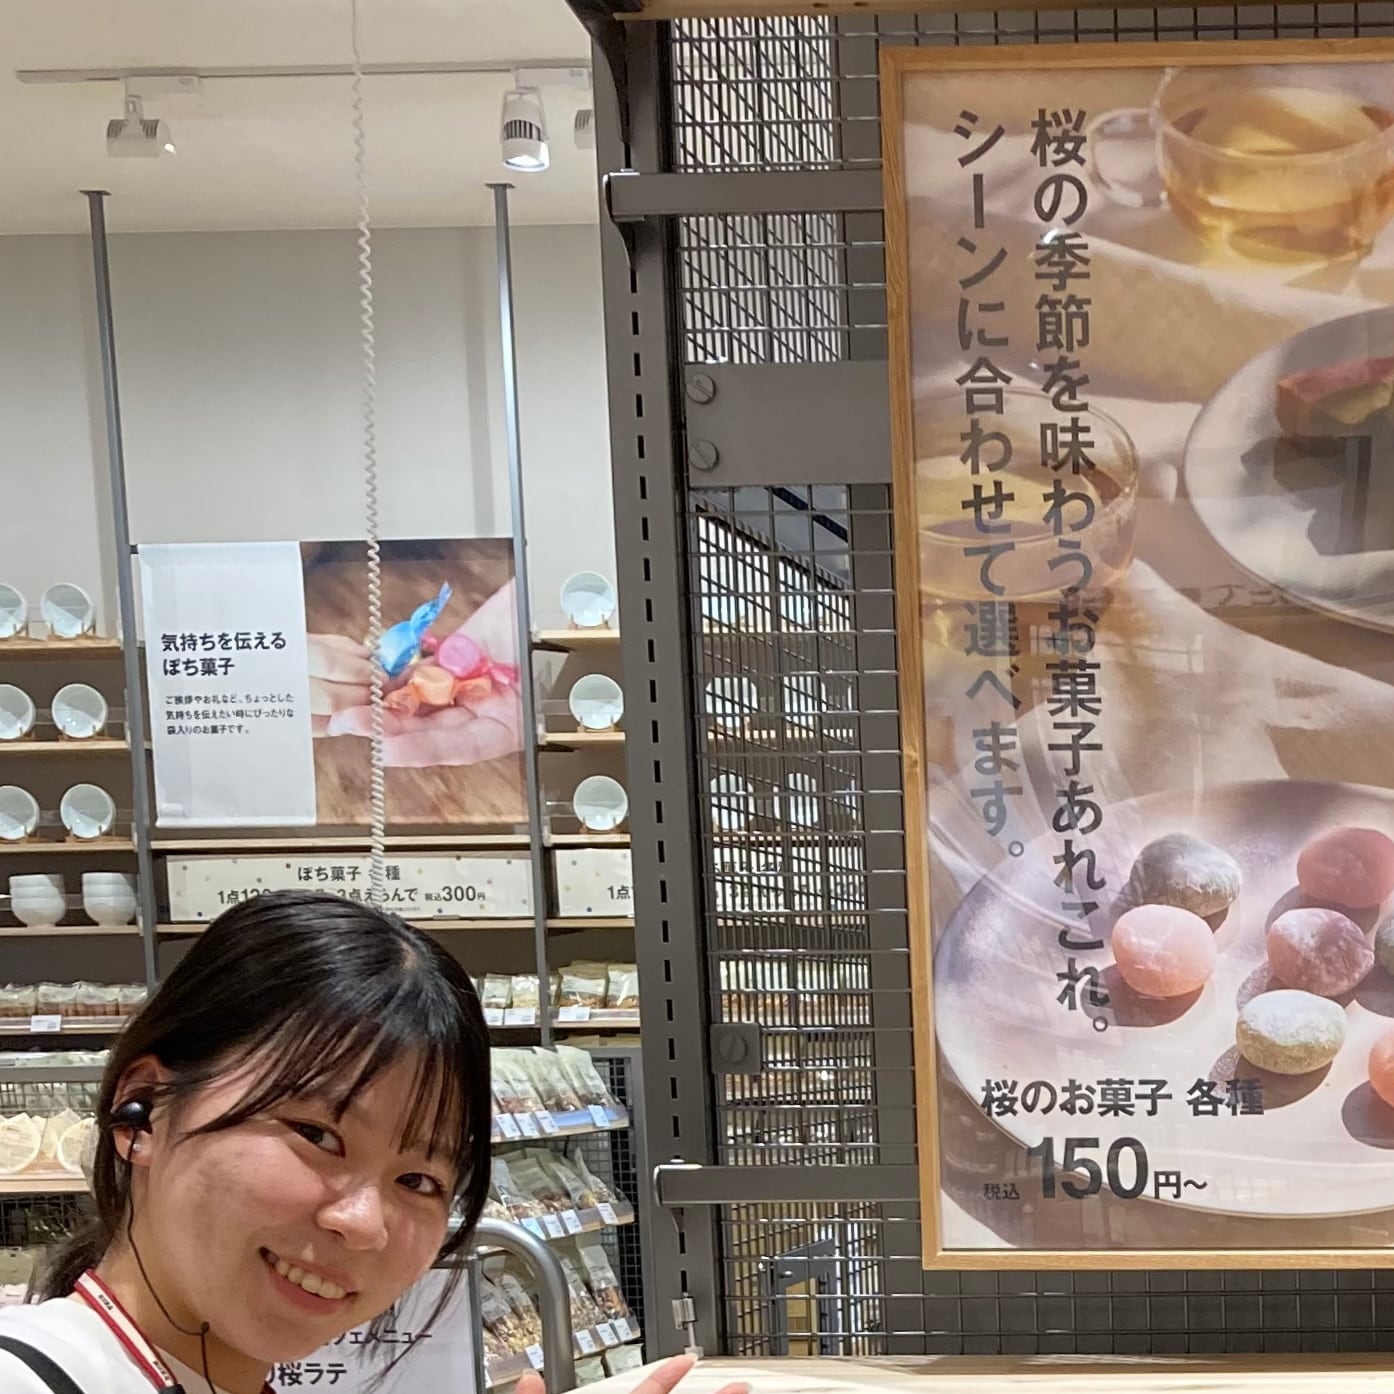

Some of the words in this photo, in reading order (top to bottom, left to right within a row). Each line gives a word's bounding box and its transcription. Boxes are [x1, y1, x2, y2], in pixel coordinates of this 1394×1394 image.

[161, 632, 287, 652] 気持ちを伝える
[953, 109, 1025, 859] シーンに合わせて選べます。
[1031, 107, 1111, 1033] 桜の季節を味わうお菓子あれこれ。
[981, 1078, 1173, 1117] 桜のお菓子
[1186, 1079, 1264, 1116] 各種
